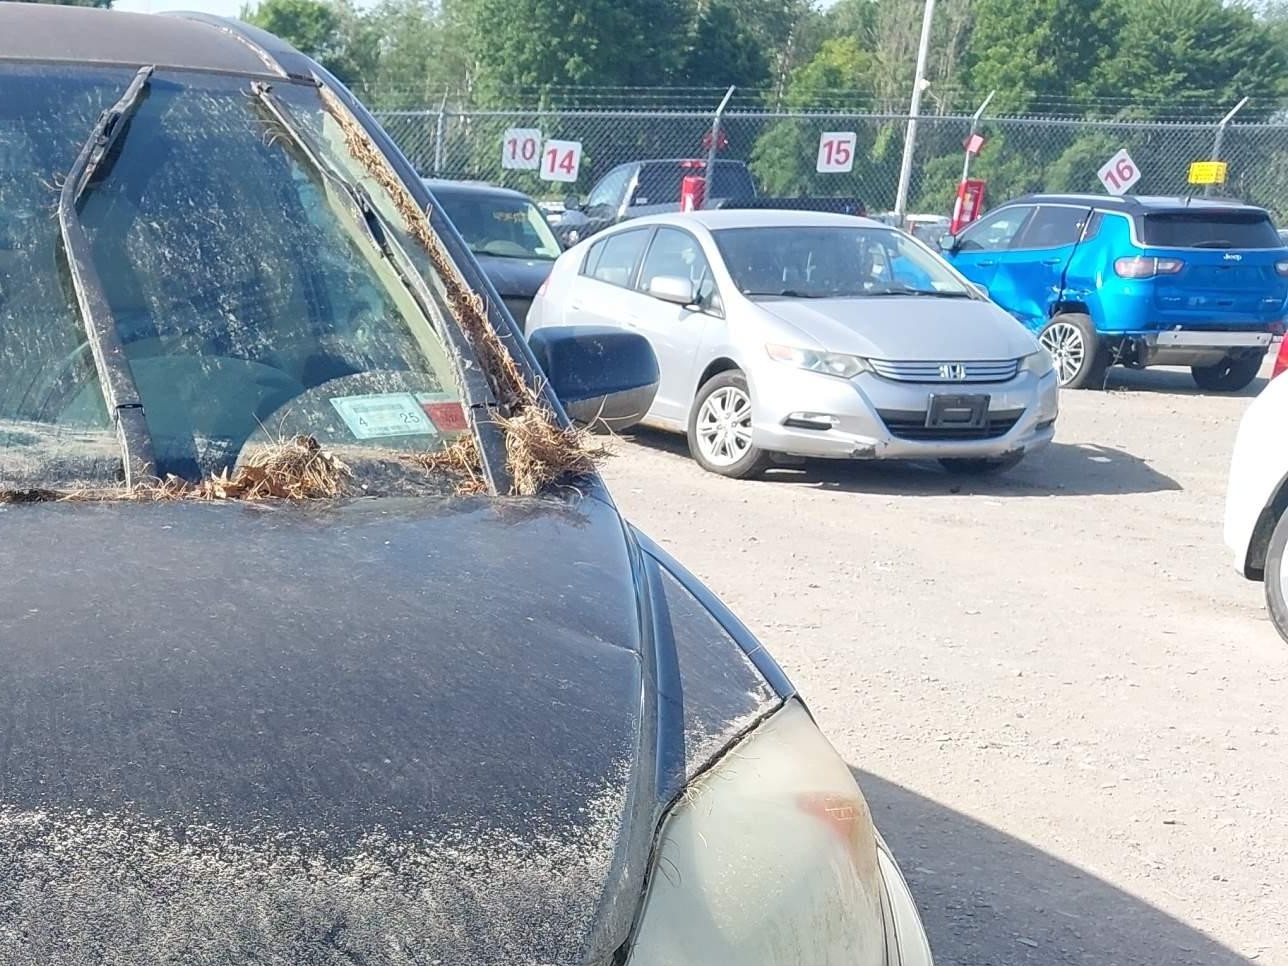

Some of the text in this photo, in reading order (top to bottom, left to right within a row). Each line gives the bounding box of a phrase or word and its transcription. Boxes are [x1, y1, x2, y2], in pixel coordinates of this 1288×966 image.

[507, 138, 536, 161] 10
[546, 147, 576, 175] 14
[823, 139, 851, 166] 15
[1104, 158, 1135, 190] 16
[399, 411, 421, 424] 25
